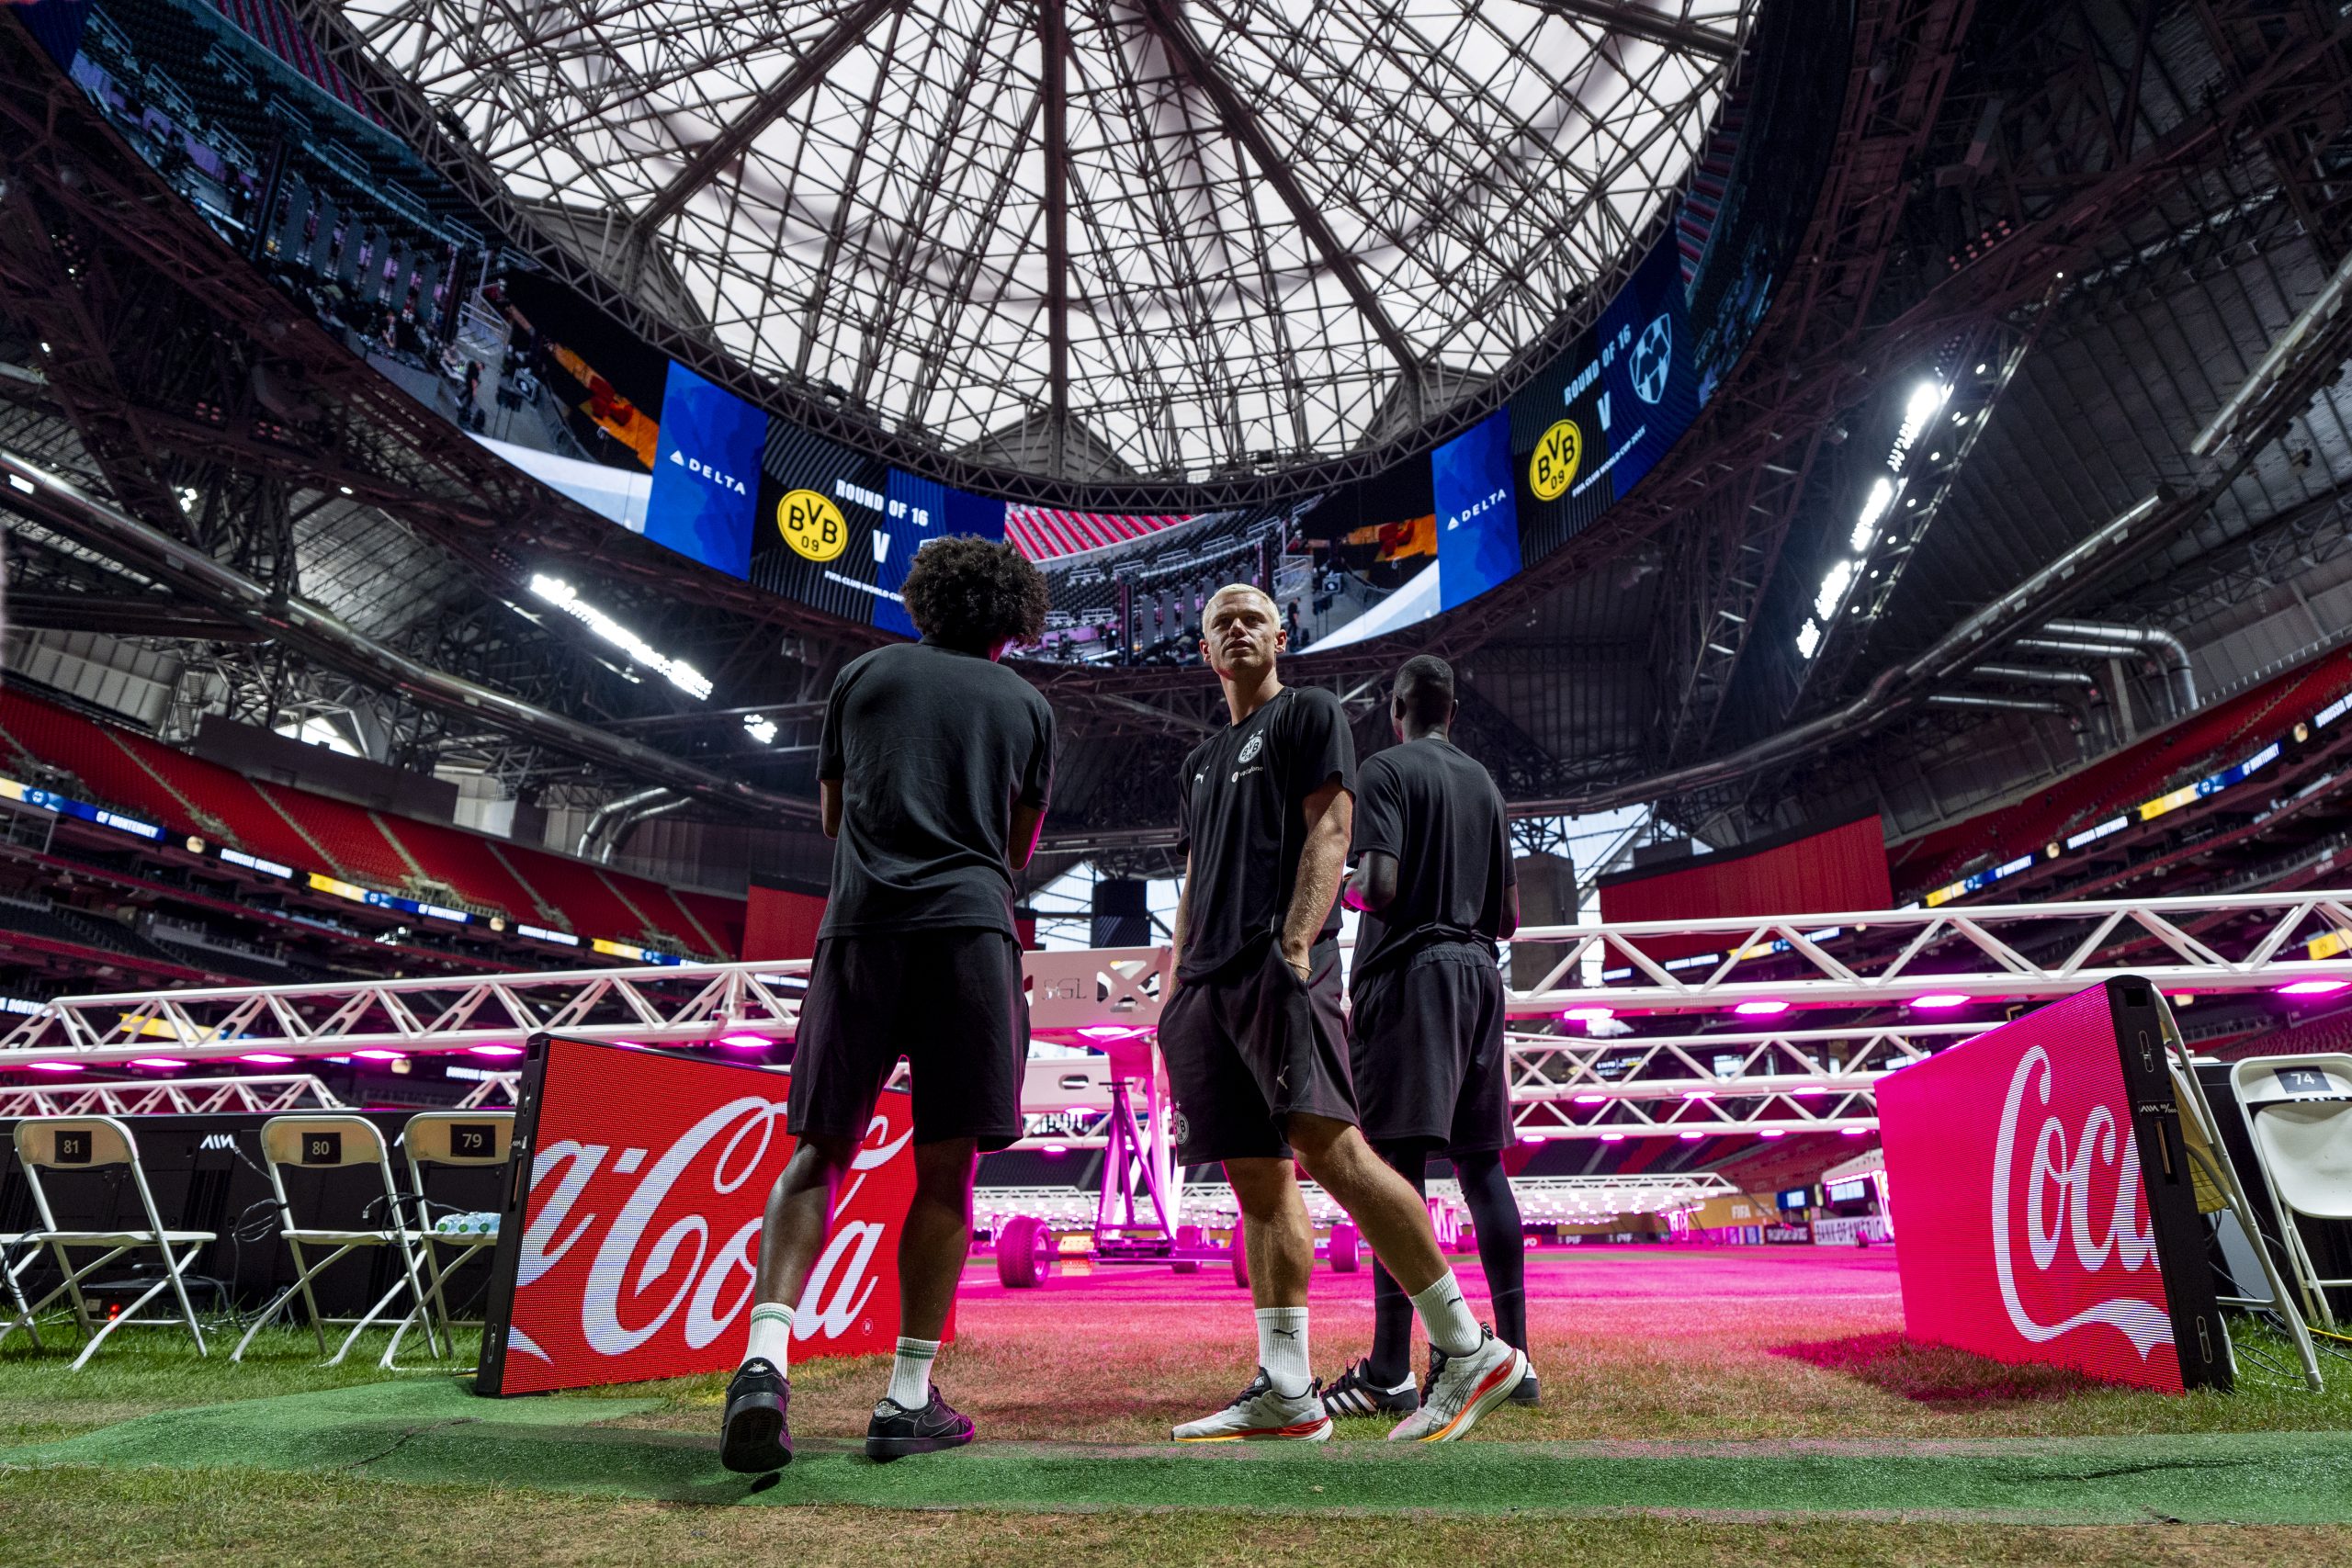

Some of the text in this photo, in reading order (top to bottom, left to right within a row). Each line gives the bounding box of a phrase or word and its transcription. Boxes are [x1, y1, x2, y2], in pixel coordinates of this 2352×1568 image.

[1564, 323, 1632, 406] ROUND OF 16
[1597, 390, 1611, 433] V
[1537, 429, 1575, 485] BVB
[1585, 469, 1600, 487] CLUB
[1600, 451, 1621, 474] WORLD
[1620, 440, 1632, 456] CUP
[688, 457, 746, 496] DELTA
[1550, 469, 1566, 491] 09
[836, 479, 929, 527] ROUND OF 16
[1461, 489, 1507, 522] DELTA
[788, 498, 838, 545] BVB
[801, 535, 820, 552] 09
[872, 529, 891, 563] V
[824, 570, 842, 583] FIFA
[842, 577, 862, 590] CLUB
[862, 582, 889, 598] WORLD
[1242, 739, 1260, 757] BVB
[107, 814, 159, 839] MONTERREY
[1042, 977, 1087, 1000] SGL
[2290, 1073, 2315, 1085] 74
[63, 1140, 79, 1154] 81
[311, 1141, 330, 1156] 80
[462, 1134, 482, 1148] 79
